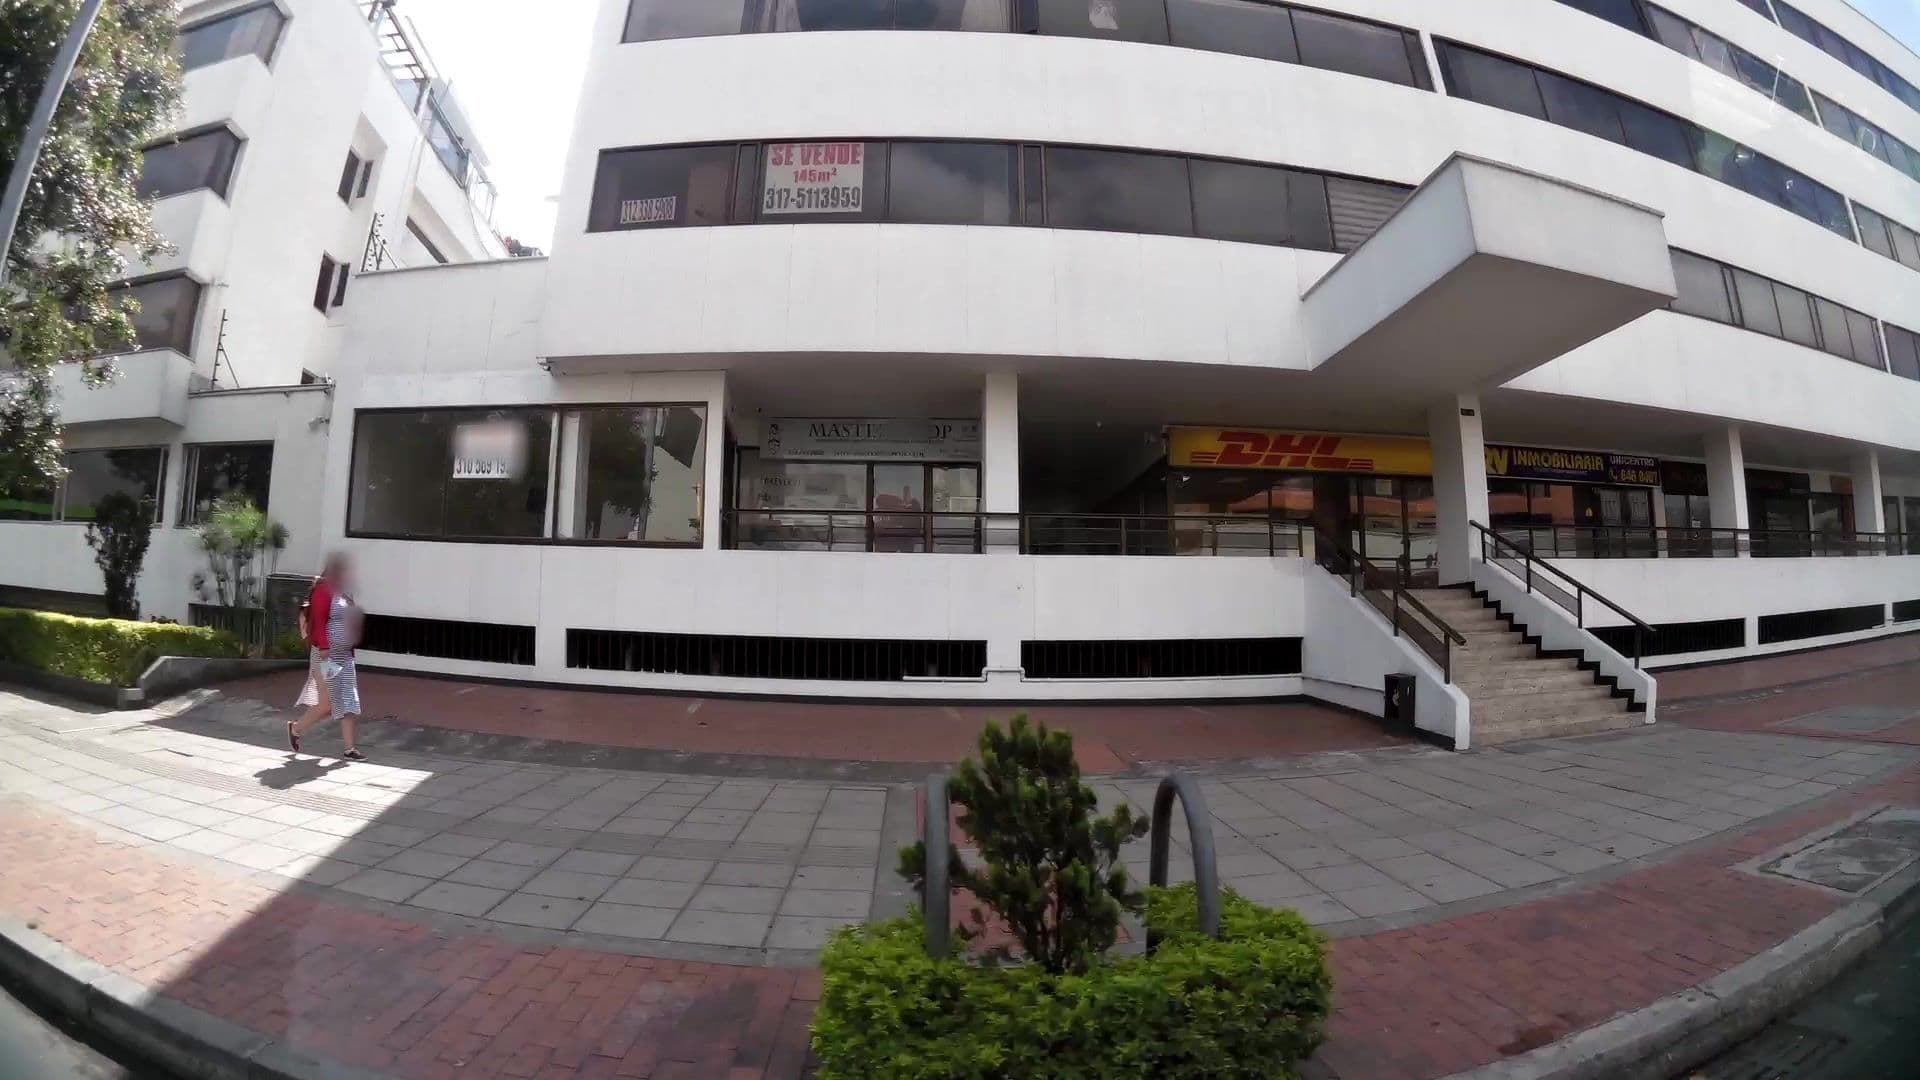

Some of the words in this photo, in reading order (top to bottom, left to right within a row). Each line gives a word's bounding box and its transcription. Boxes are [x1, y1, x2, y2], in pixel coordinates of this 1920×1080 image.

[771, 144, 794, 166] SE
[801, 143, 861, 165] VENDE
[764, 186, 862, 209] 317-5113959
[1215, 431, 1351, 469] DHL
[1512, 448, 1604, 471] INMOBILIARIA
